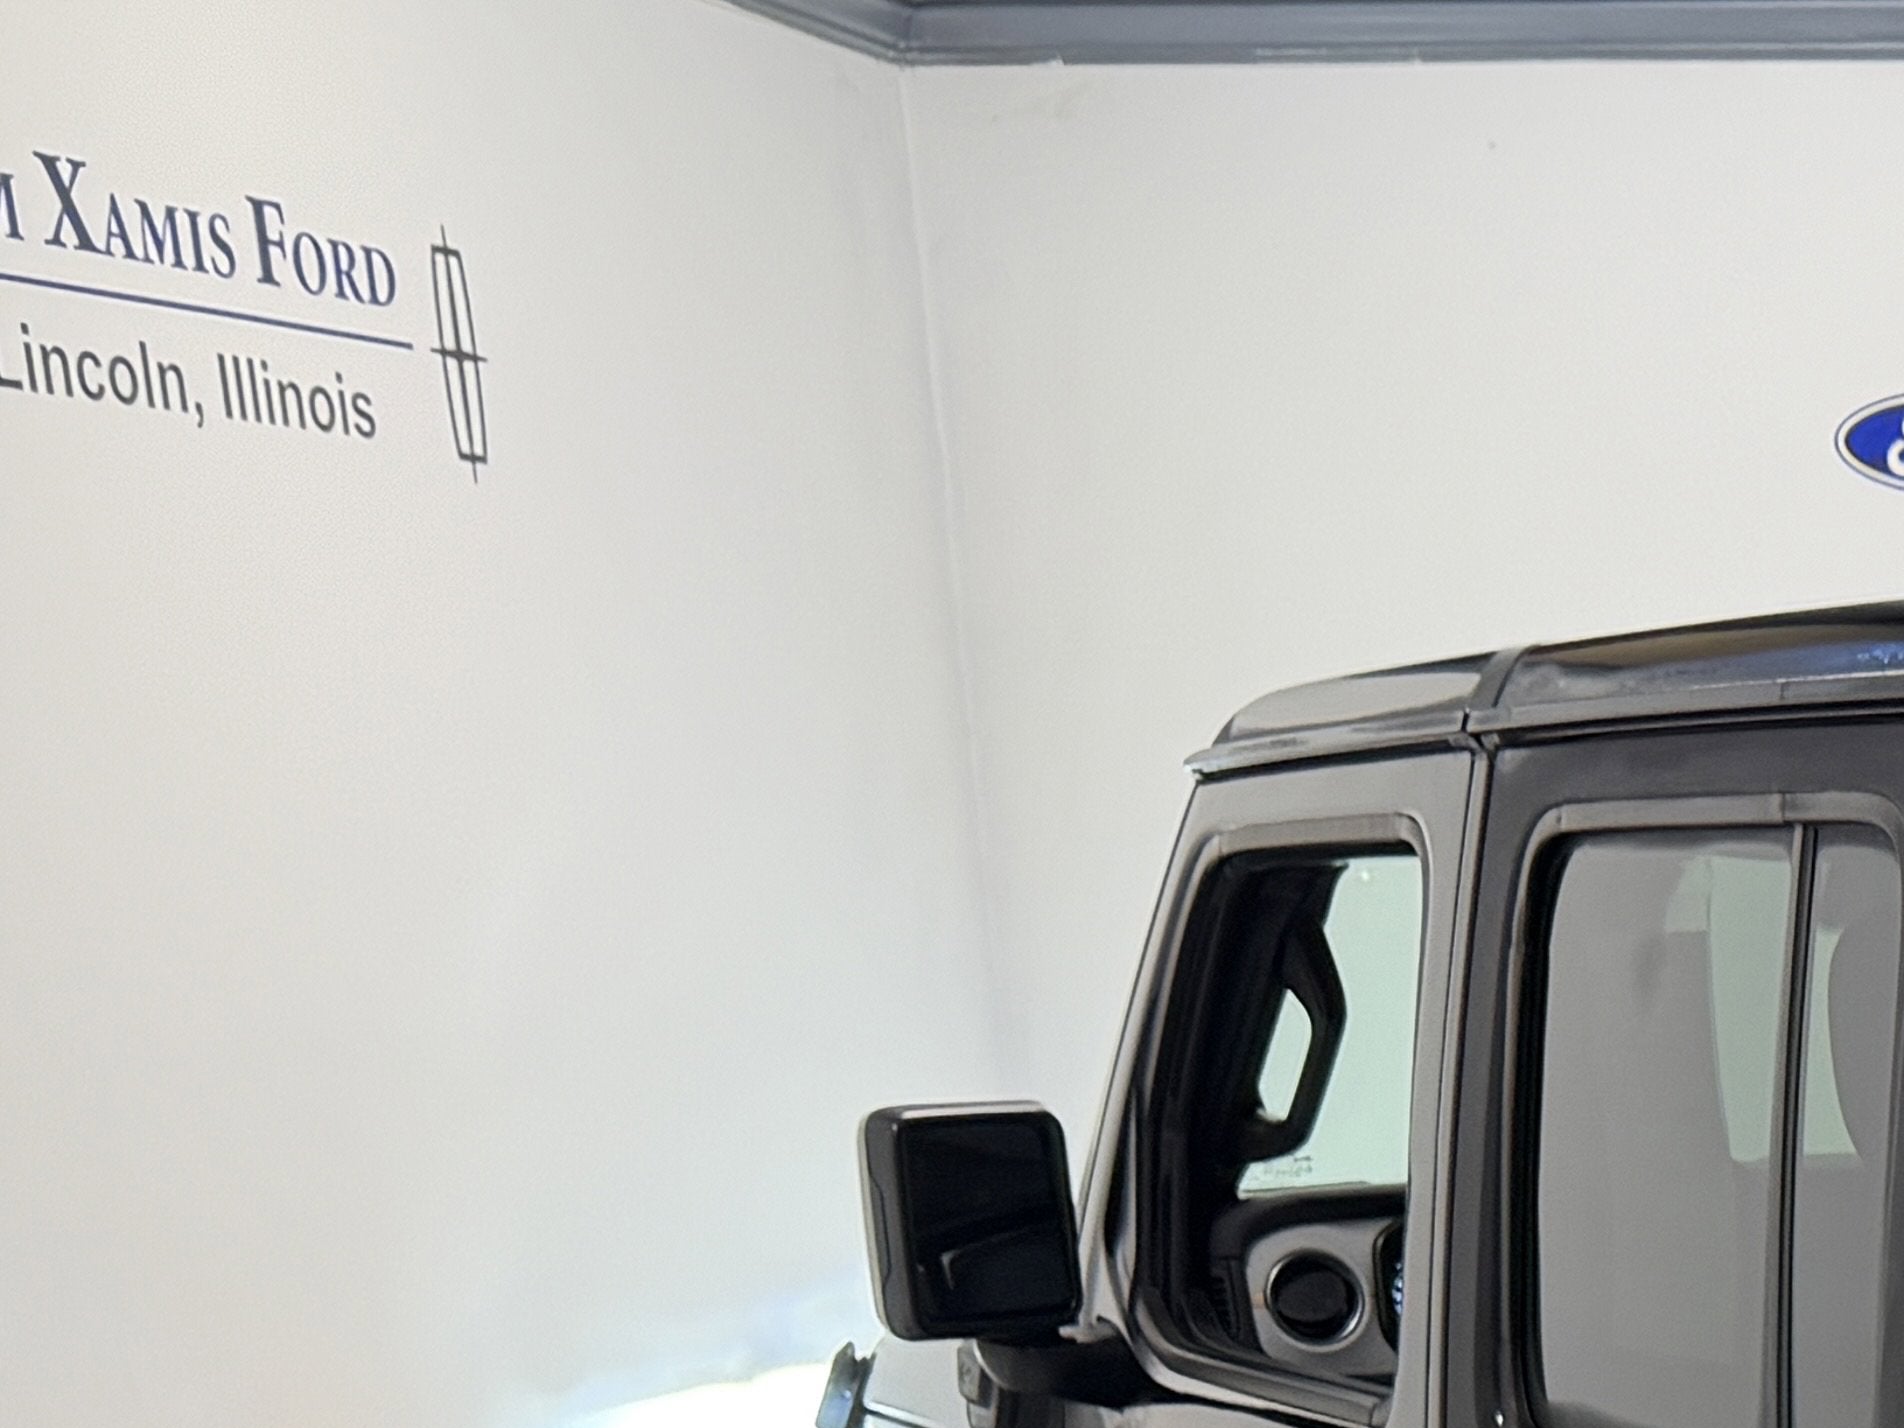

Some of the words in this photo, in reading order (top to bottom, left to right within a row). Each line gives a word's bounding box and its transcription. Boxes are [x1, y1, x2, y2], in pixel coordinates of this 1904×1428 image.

[32, 149, 238, 280] XAMIS
[245, 194, 398, 307] FORD
[216, 351, 378, 440] Illinois
